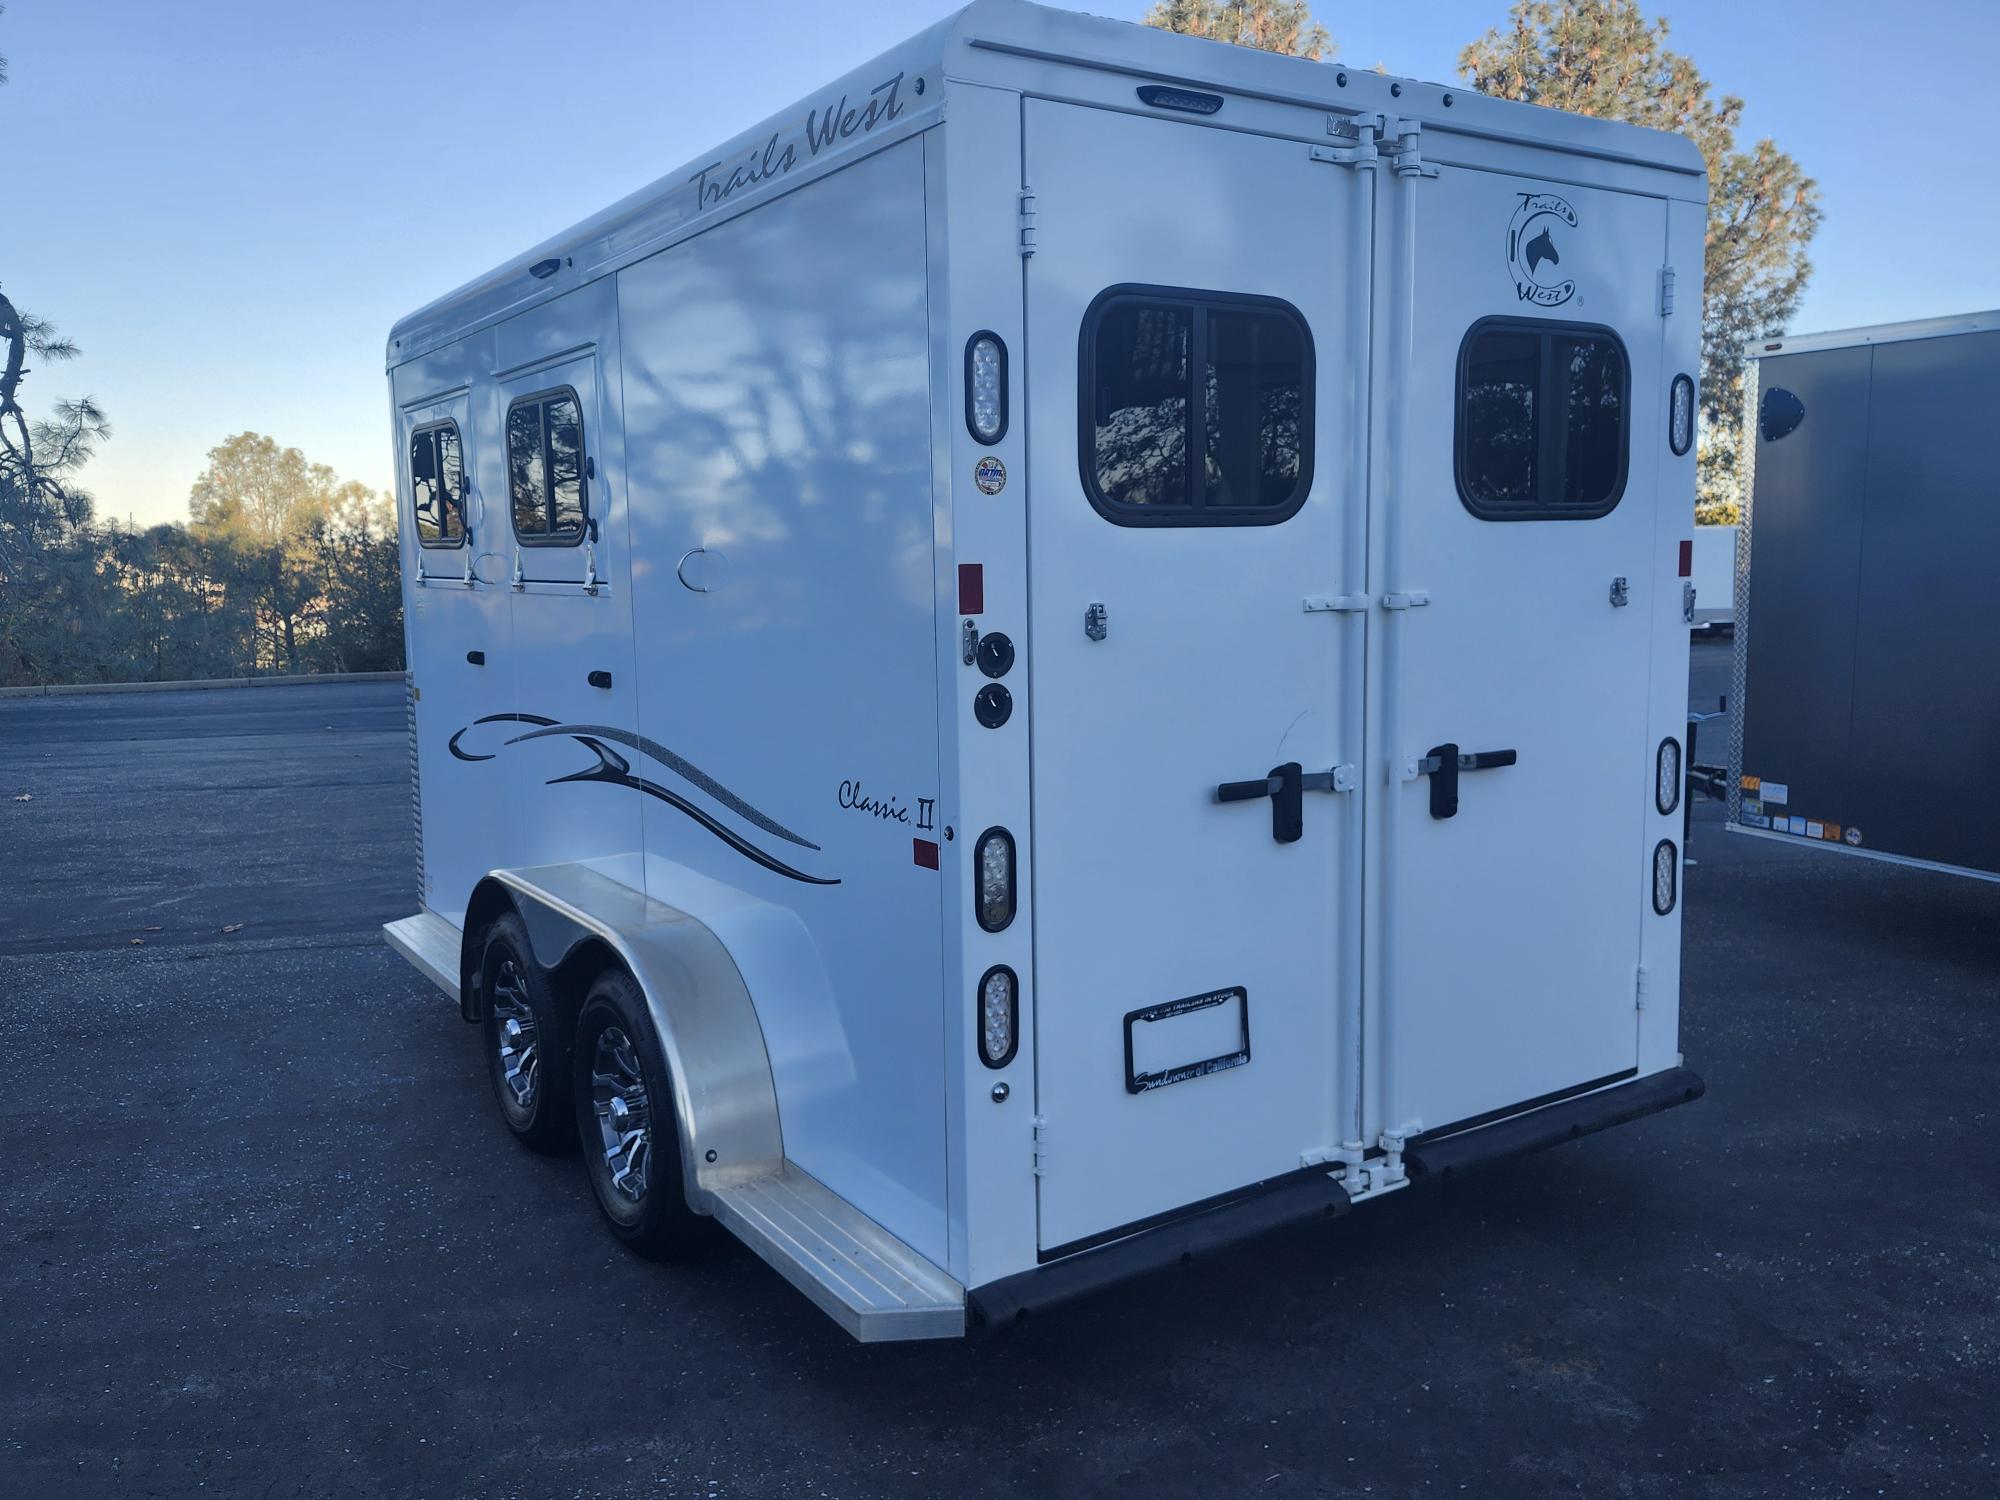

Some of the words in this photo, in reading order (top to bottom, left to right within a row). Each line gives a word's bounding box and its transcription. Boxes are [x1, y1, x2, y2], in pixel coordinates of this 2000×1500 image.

[688, 132, 796, 211] Trails
[806, 71, 904, 155] West
[1516, 192, 1567, 213] Trails
[1517, 281, 1561, 301] West
[838, 780, 909, 823] Classic
[916, 797, 935, 831] II
[1205, 1053, 1248, 1073] California
